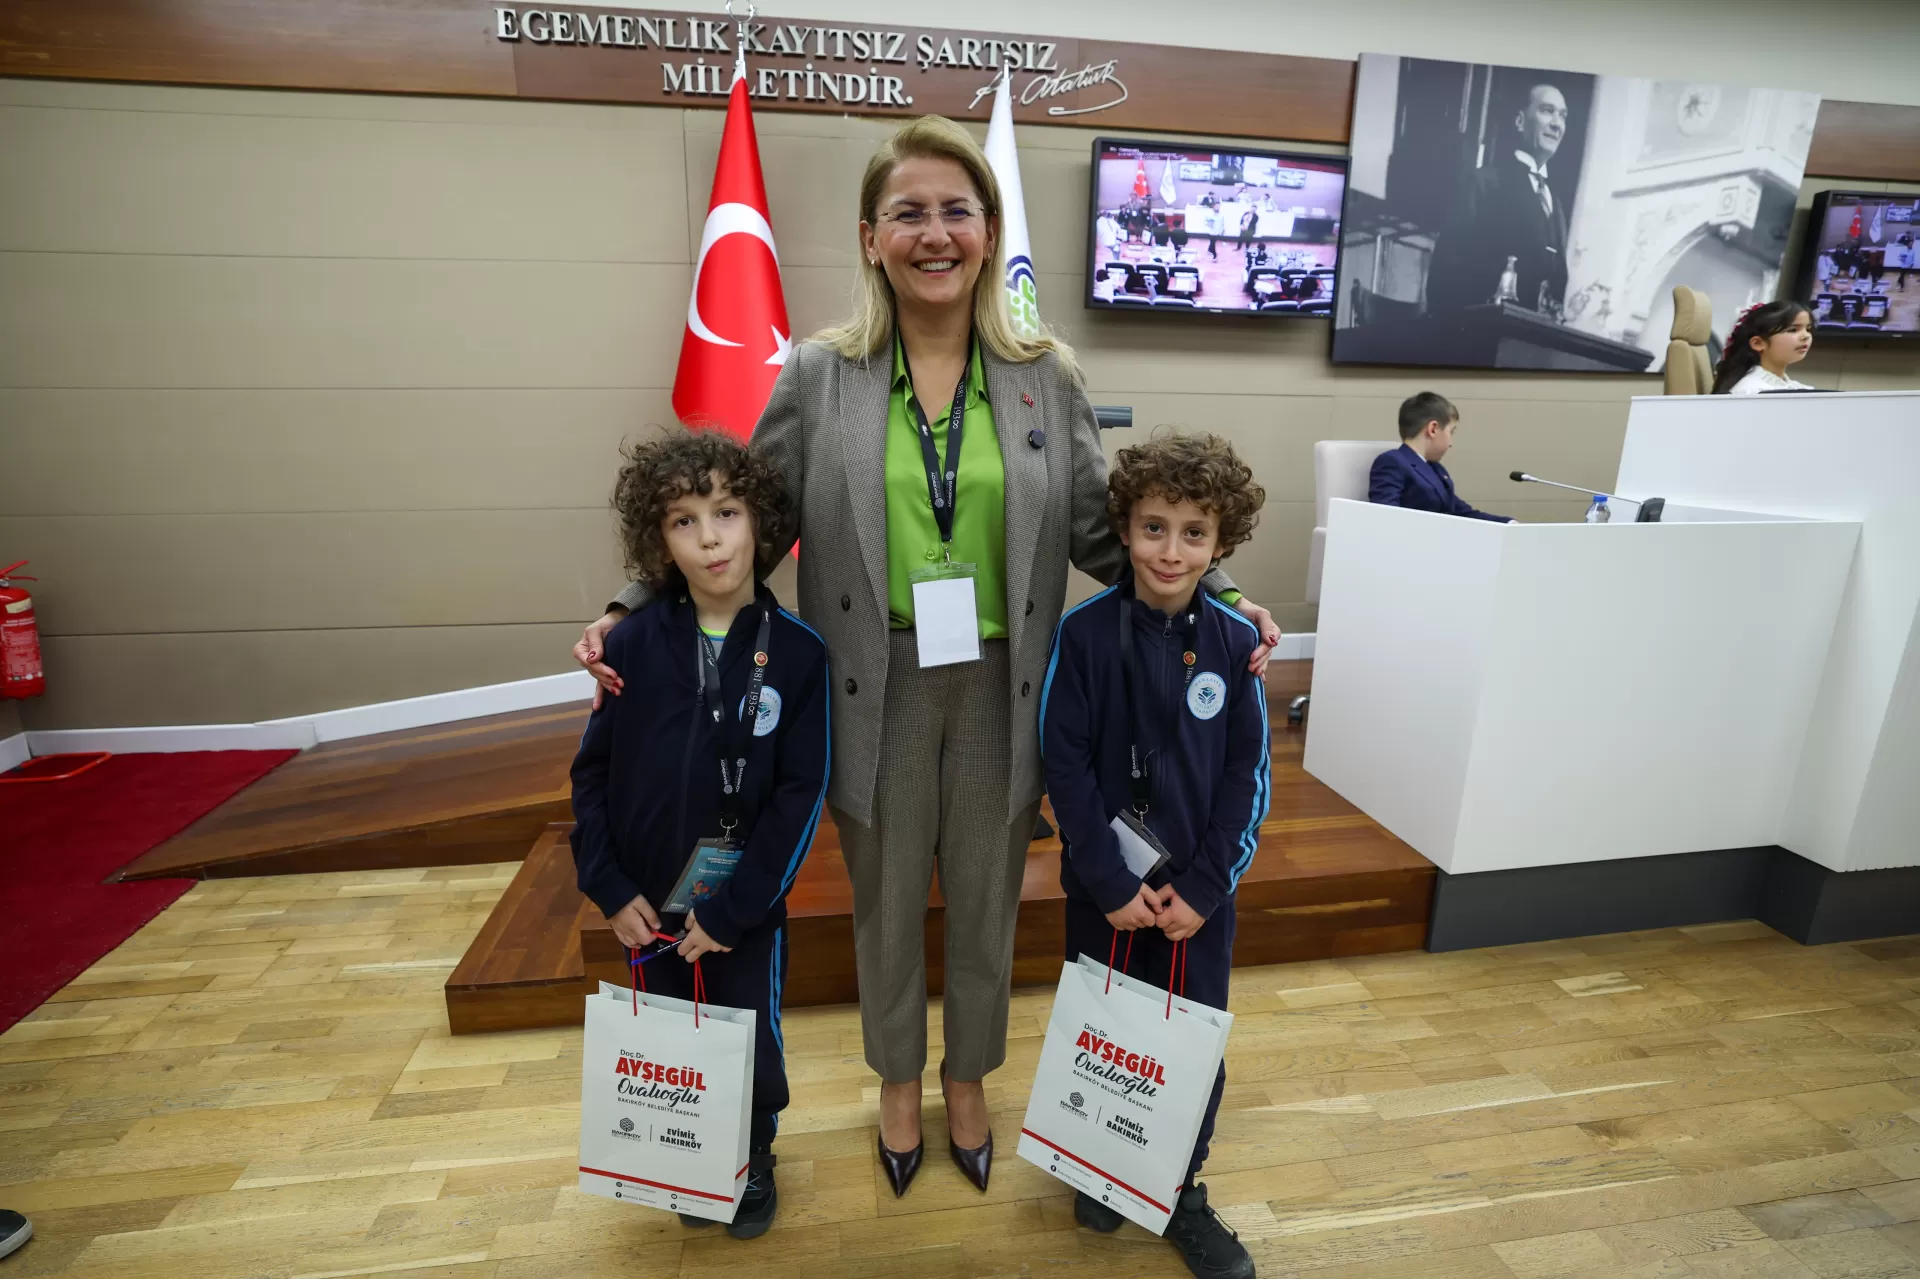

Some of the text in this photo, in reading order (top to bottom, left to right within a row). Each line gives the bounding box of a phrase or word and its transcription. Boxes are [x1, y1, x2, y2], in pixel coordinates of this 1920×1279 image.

[495, 7, 1058, 71] EGEMENLİK KAYITSIZ ŞARTSIZ
[661, 57, 914, 105] MİLETİNDİR.
[615, 1056, 707, 1092] AYŞEGÜL
[1075, 1030, 1166, 1086] AYŞEGÜL
[1075, 1052, 1157, 1097] Ovalıoğlu
[617, 1077, 701, 1108] Ovalıoğlu
[1072, 1069, 1100, 1086] BAKIRKÖY
[1128, 1097, 1153, 1112] BAŞKANI
[617, 1097, 646, 1107] BAKIRKÖY
[675, 1108, 700, 1118] BAŞKANI
[667, 1127, 696, 1140] EVİMİZ
[1106, 1120, 1149, 1146] BAKIRKÖY
[1115, 1114, 1144, 1135] EVİMİZ
[659, 1135, 702, 1150] BAKIRKÖY
